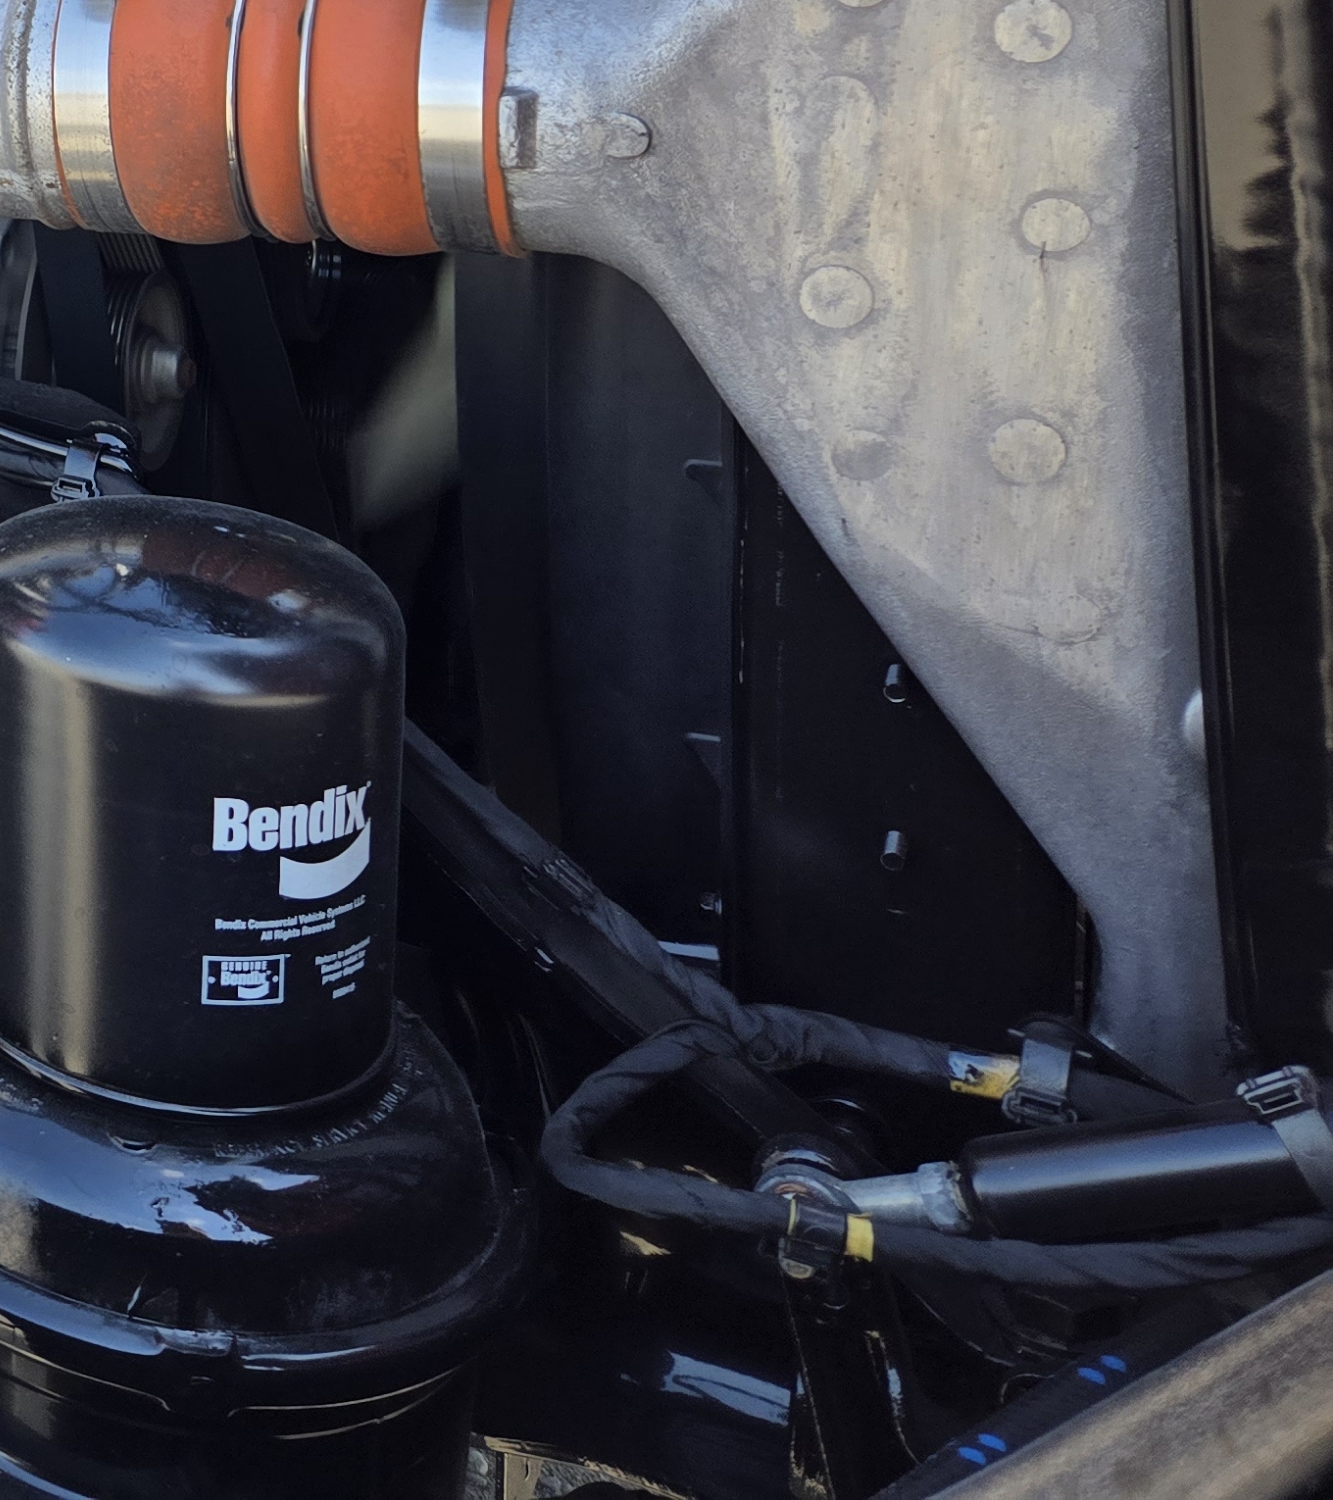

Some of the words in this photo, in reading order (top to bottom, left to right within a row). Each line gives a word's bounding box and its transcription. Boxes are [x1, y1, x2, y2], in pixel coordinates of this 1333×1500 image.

[212, 784, 367, 852] Bendix
[214, 918, 247, 931] Bendix
[247, 915, 298, 930] Commercial
[299, 910, 326, 925] Vehicle
[260, 930, 273, 942] All
[273, 927, 301, 942] Rights
[301, 919, 336, 936] Reserved
[220, 961, 268, 971] GENUINE
[220, 971, 267, 986] Bendix
